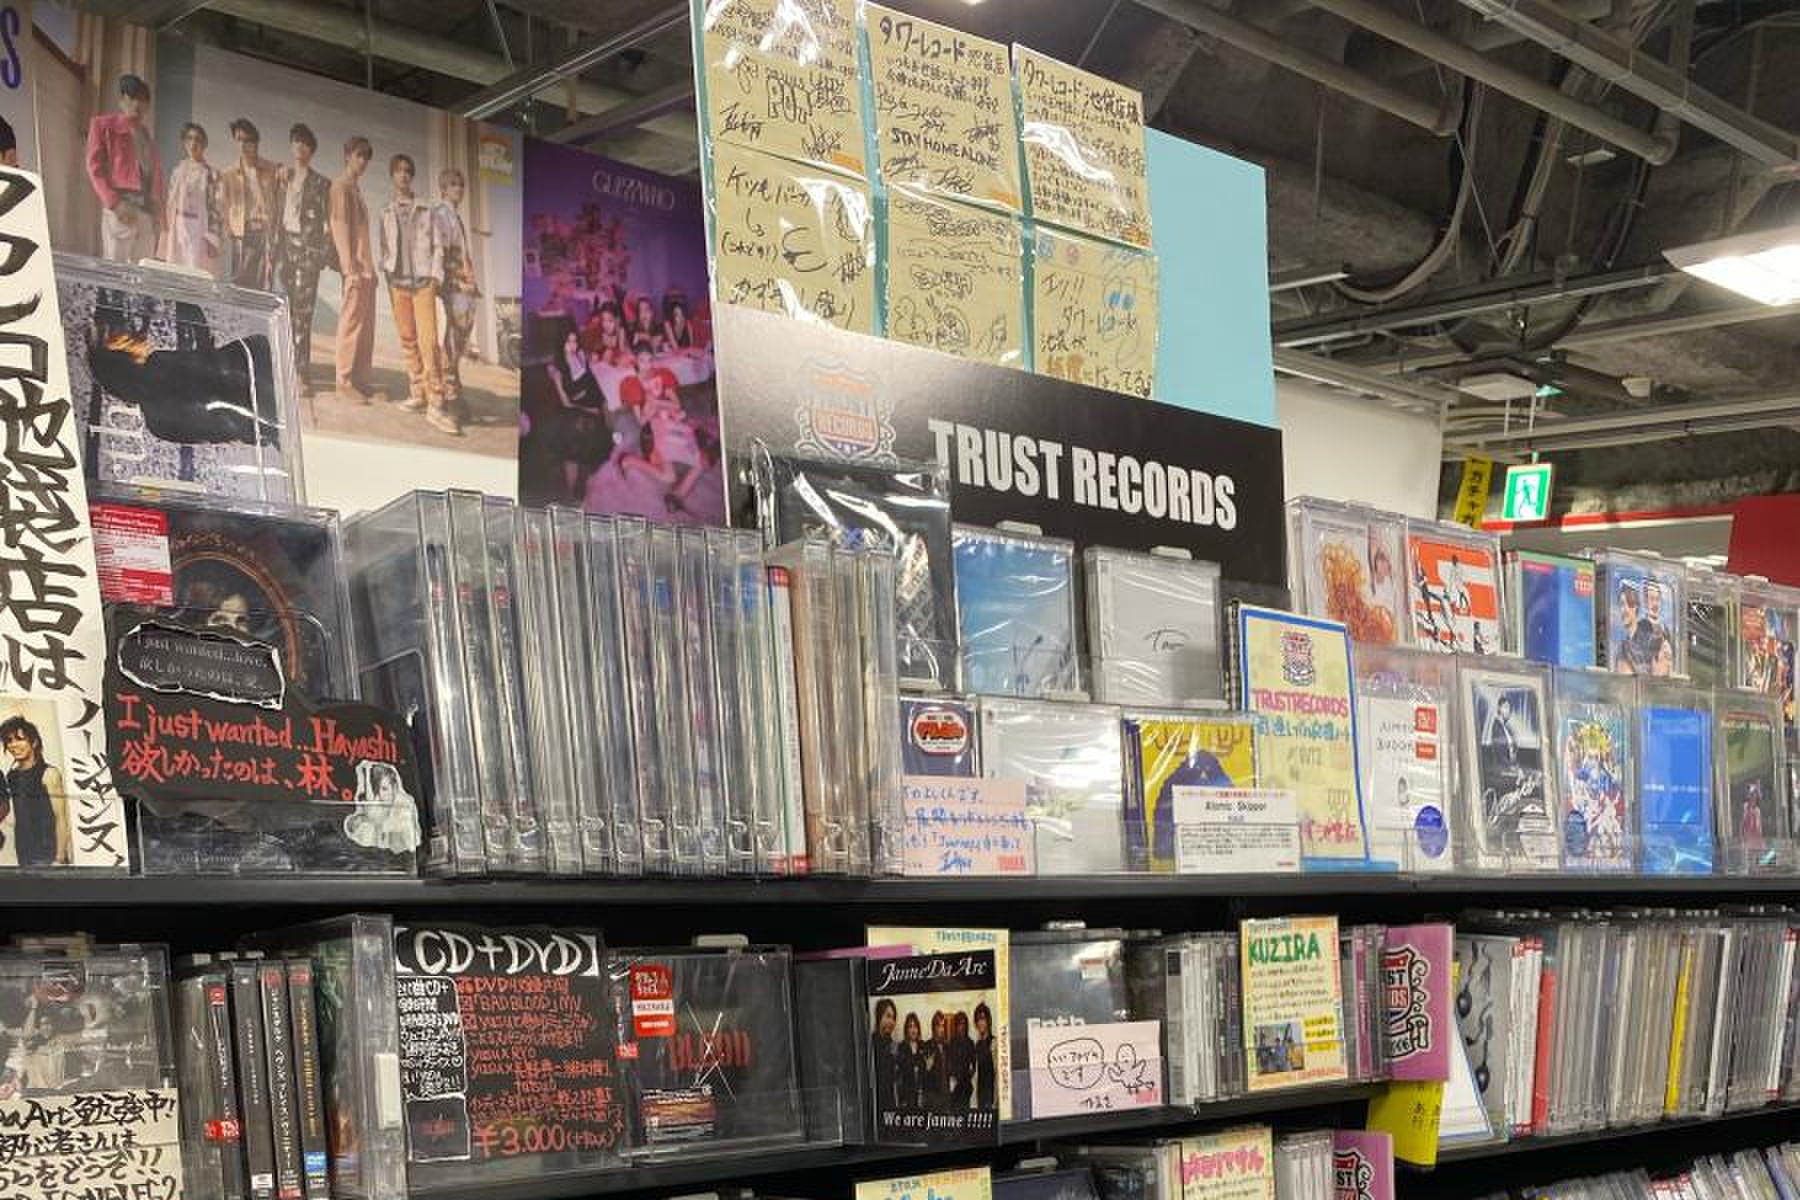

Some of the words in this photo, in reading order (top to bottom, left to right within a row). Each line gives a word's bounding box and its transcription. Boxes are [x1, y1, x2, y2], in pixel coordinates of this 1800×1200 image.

[928, 418, 1064, 500] TRUST
[1072, 446, 1238, 531] RECORDS
[116, 694, 143, 728] I
[146, 702, 203, 743] just
[1248, 932, 1322, 966] KUZIRA
[903, 1113, 925, 1128] are
